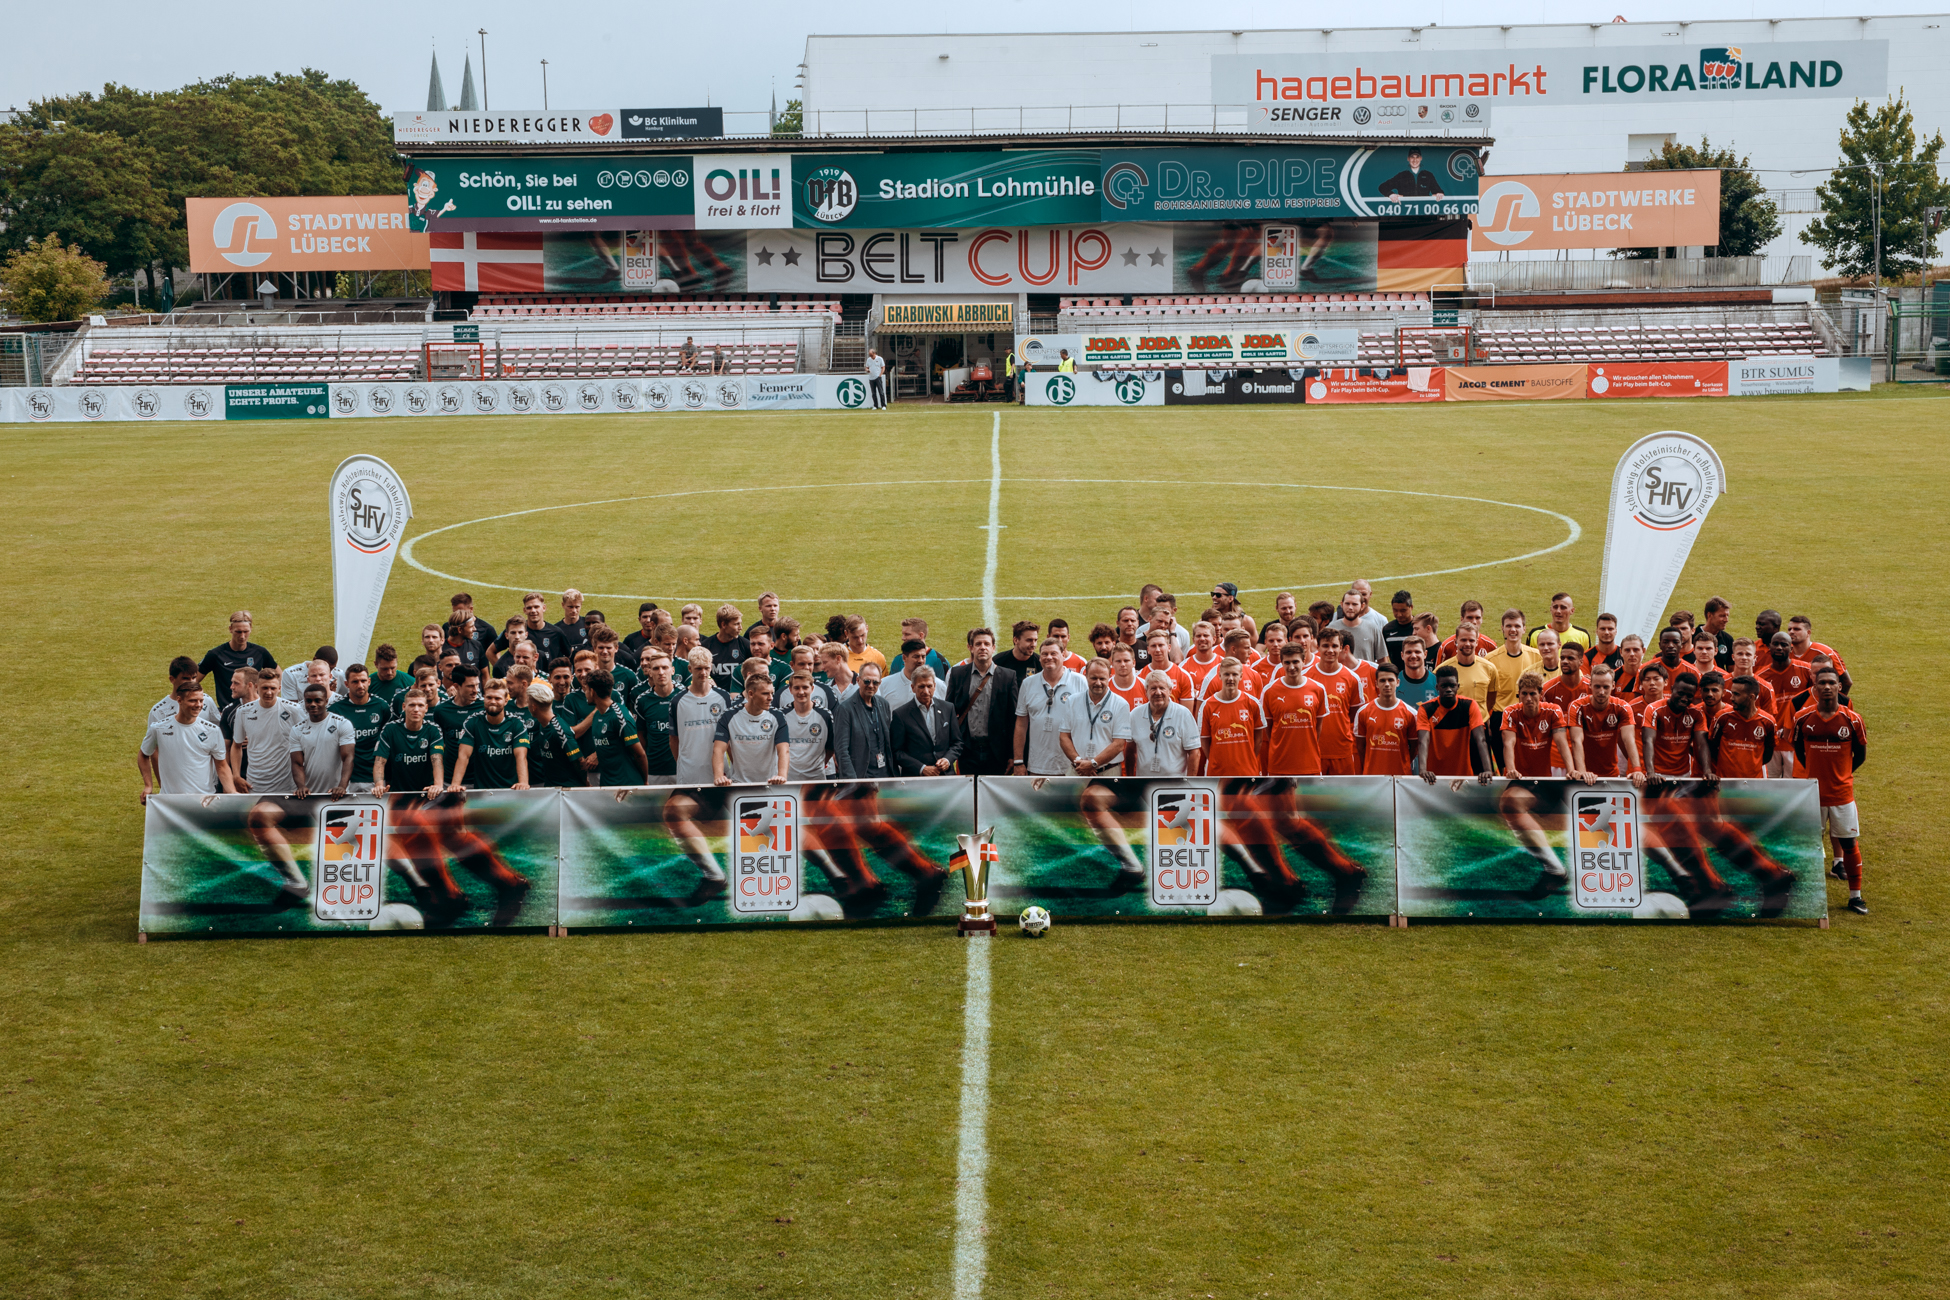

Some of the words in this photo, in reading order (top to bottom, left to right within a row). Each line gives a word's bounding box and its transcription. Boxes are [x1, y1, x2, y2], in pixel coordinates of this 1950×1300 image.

[1256, 64, 1547, 102] hagebaumarkt
[1582, 64, 1697, 93] FLORA
[1745, 60, 1843, 90] LAND
[645, 118, 657, 126] BG
[660, 117, 697, 126] Klinikum
[1270, 107, 1341, 121] SENGER
[449, 117, 581, 133] NIEDEREGGER
[459, 171, 522, 190] Schön,
[525, 174, 549, 187] Sie
[553, 173, 577, 187] bei
[819, 168, 840, 177] 1919
[1237, 158, 1336, 198] PIPE
[704, 168, 781, 202] OIL!
[879, 177, 969, 201] Stadion
[977, 174, 1095, 198] Lohmühle
[506, 195, 541, 211] OIL!
[545, 200, 562, 210] zu
[567, 197, 613, 210] sehen
[1155, 199, 1251, 210] ROHRSANIERUNG
[1255, 198, 1281, 208] ZUM
[1285, 197, 1341, 208] FESTPREIS
[1552, 189, 1696, 209] STADTWERKE
[707, 205, 733, 216] frei
[737, 205, 747, 216] &
[751, 204, 781, 216] flott
[816, 211, 845, 220] LÜBECK
[1377, 204, 1401, 216] 040
[1405, 204, 1419, 215] 71
[1424, 204, 1440, 215] 00
[1443, 203, 1459, 215] 66
[1462, 203, 1478, 214] 00
[1553, 211, 1633, 232] LÜBECK
[291, 233, 371, 254] LÜBECK
[626, 257, 653, 268] BELT
[815, 231, 959, 284] BELT
[967, 228, 1113, 287] CUP
[1266, 257, 1294, 268] BELT
[626, 268, 653, 279] CUP
[1266, 268, 1294, 279] CUP
[887, 305, 953, 323] GRABOWSKI
[957, 304, 1009, 322] ABBRUCH
[1453, 349, 1460, 357] 6
[1475, 349, 1489, 358] Tor
[470, 364, 476, 374] 7
[1741, 368, 1766, 378] BTR
[1770, 366, 1814, 378] SUMUS
[269, 388, 325, 396] AMATEURE.
[760, 383, 803, 393] Femern
[1254, 382, 1295, 394] hummel
[263, 397, 299, 405] PROFIS.
[1624, 444, 1691, 512] Schleswig-Holsteinischer
[1692, 452, 1718, 515] Fußballverband
[338, 468, 383, 532] Schleswig-Holsteinischer
[383, 478, 404, 540] Fußballverband
[1652, 530, 1696, 609] FUSSBALLVERBAND
[362, 556, 391, 632] FUSSBALLVERBAND
[657, 721, 669, 731] ipe
[487, 745, 512, 757] iperdi
[741, 855, 792, 874] BELT
[1159, 848, 1210, 867] BELT
[1581, 852, 1632, 870] BELT
[324, 864, 375, 882] BELT
[1158, 869, 1210, 890] CUP
[740, 876, 792, 896] CUP
[1581, 872, 1634, 892] CUP
[322, 884, 374, 905] CUP
